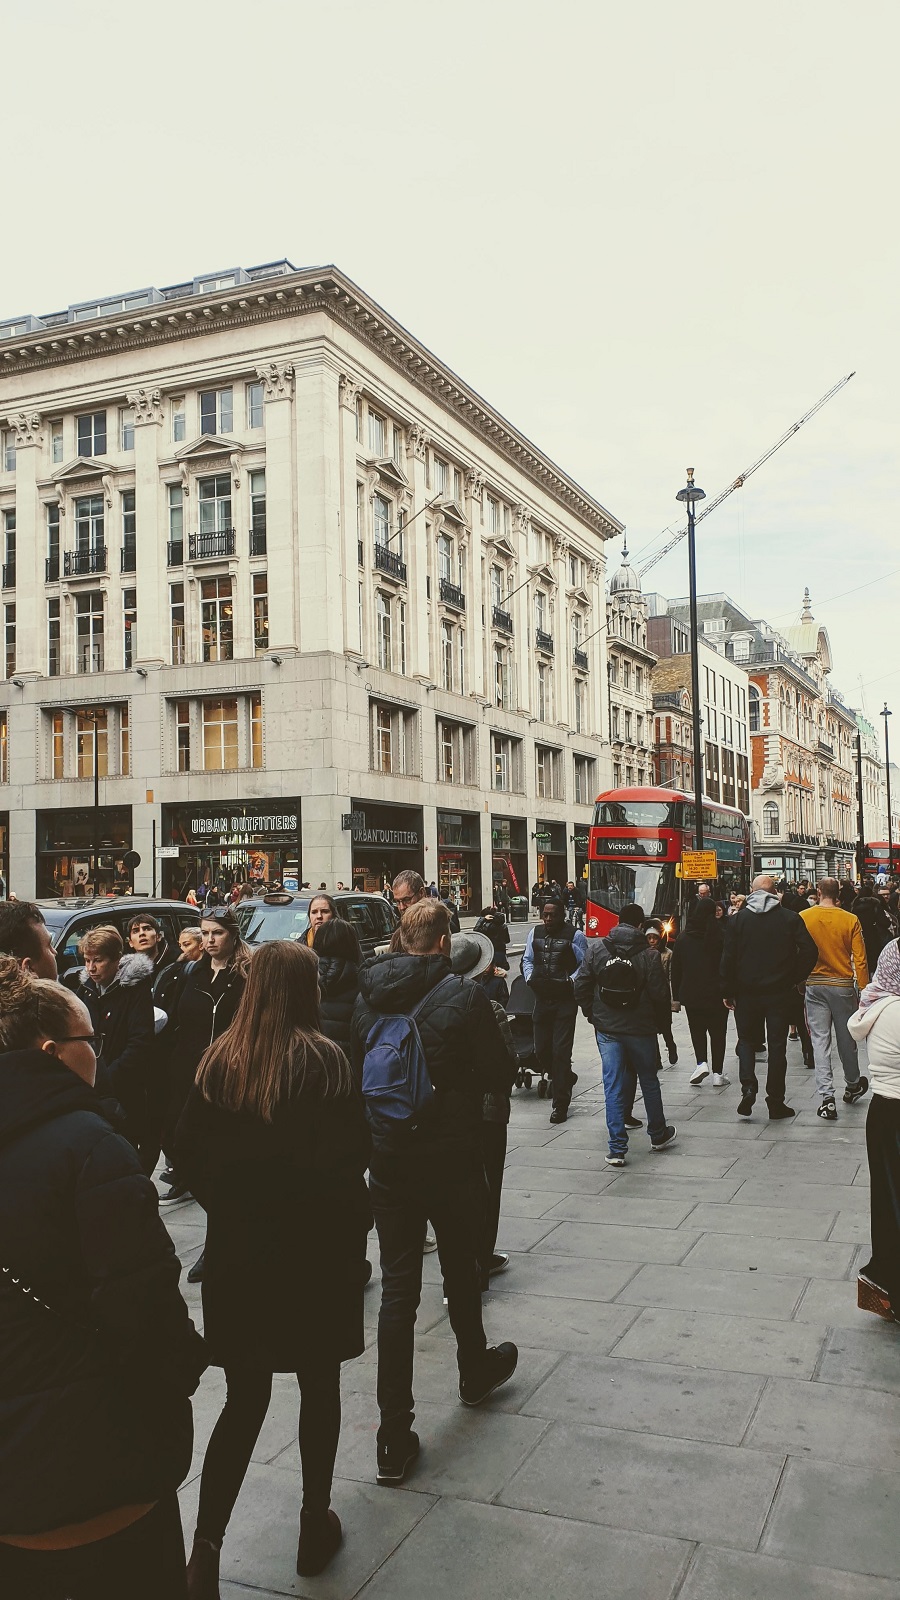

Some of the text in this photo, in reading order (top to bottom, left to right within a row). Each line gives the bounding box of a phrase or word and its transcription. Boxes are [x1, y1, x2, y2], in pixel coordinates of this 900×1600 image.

[191, 815, 298, 834] URBAN OUTFITTERS
[354, 829, 418, 844] URBAN OUTFITTERS
[607, 841, 663, 853] Victoria 390
